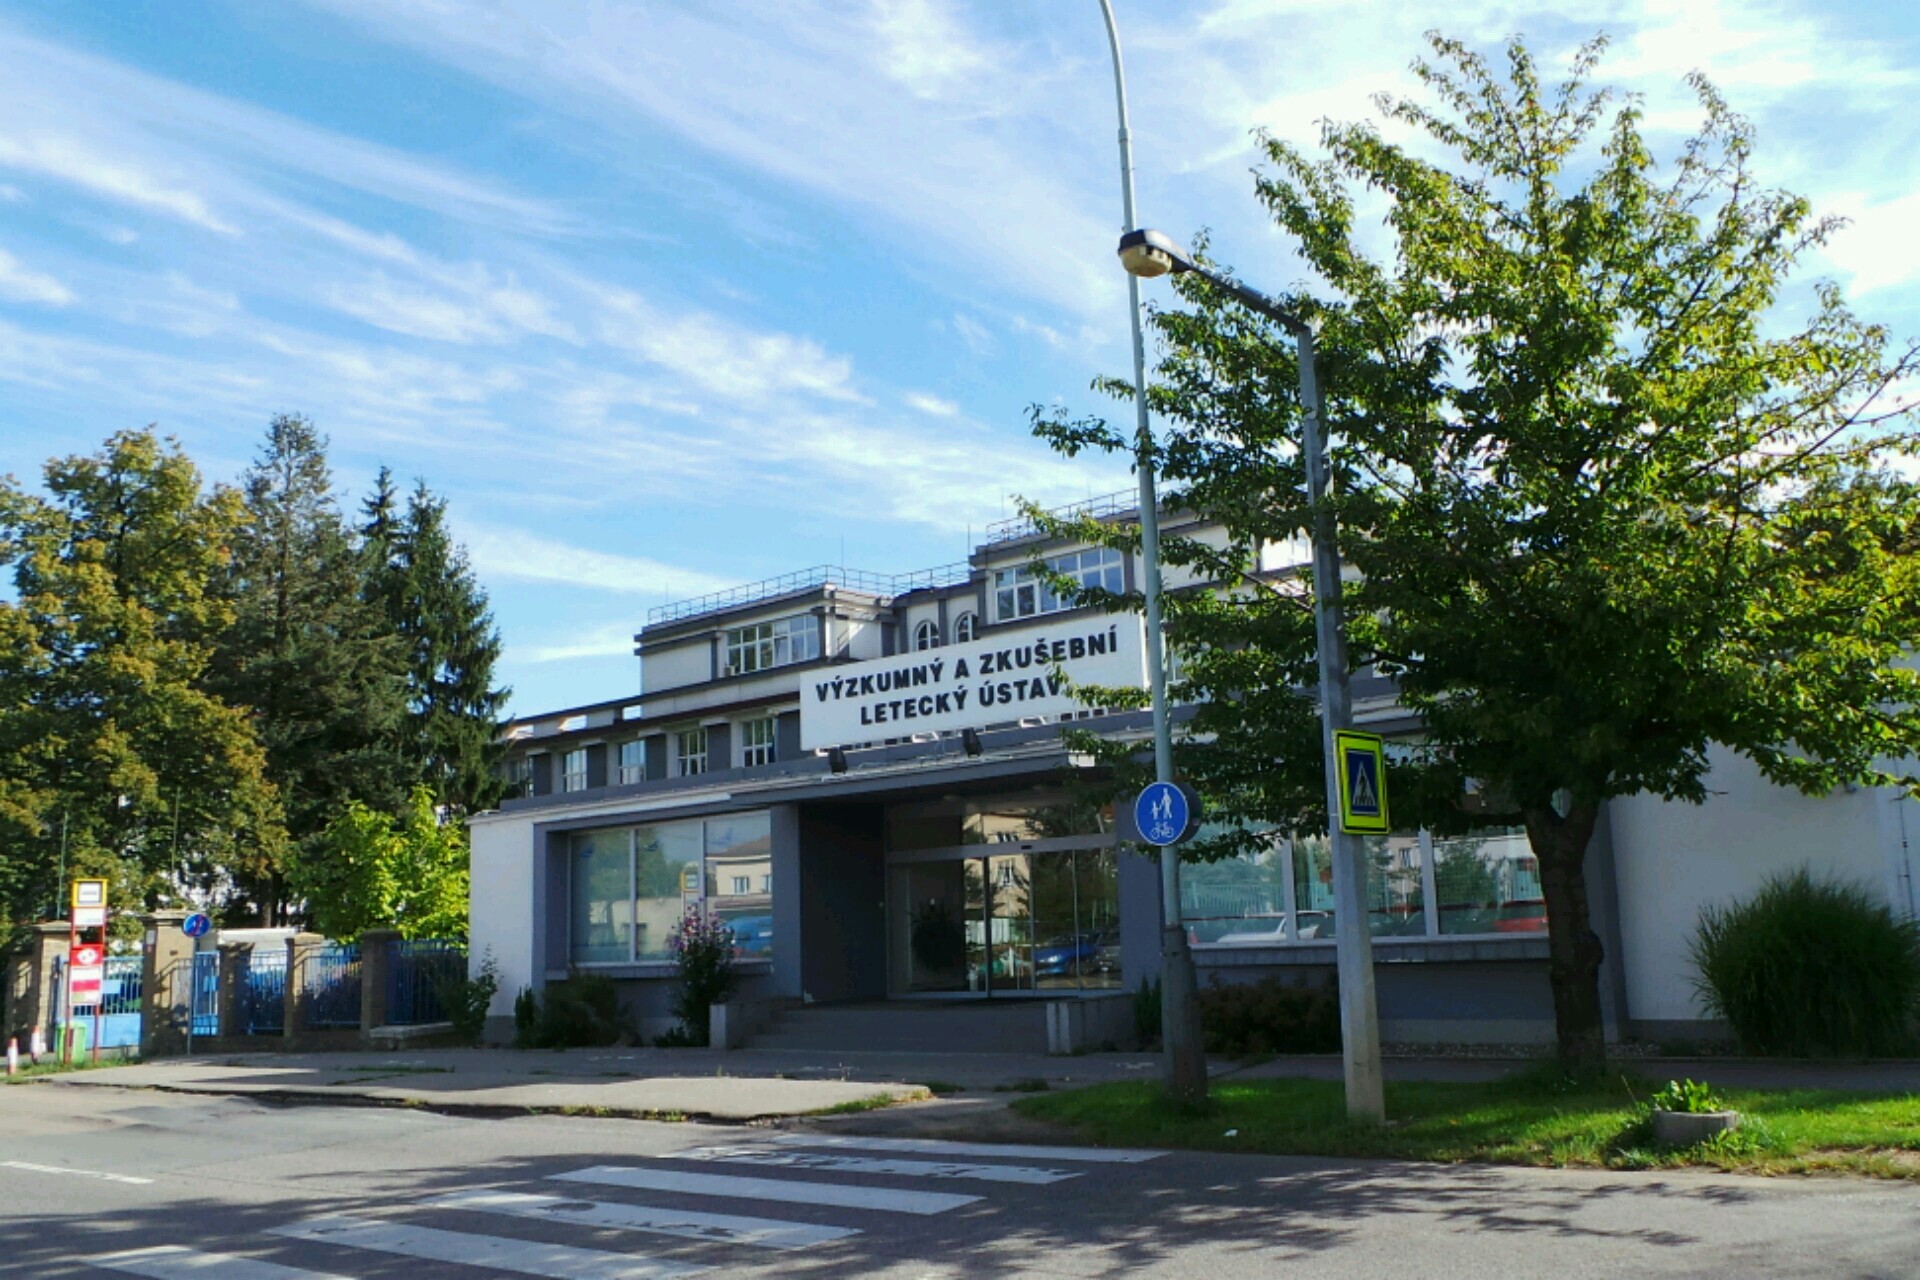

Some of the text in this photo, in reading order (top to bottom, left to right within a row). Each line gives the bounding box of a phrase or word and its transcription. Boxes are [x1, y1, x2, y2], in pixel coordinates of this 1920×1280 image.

[815, 624, 1117, 702] VÝZKUMNÝ A ZKUŠEBNÍ
[860, 675, 1061, 725] LETECKÝ ÚSTAV
